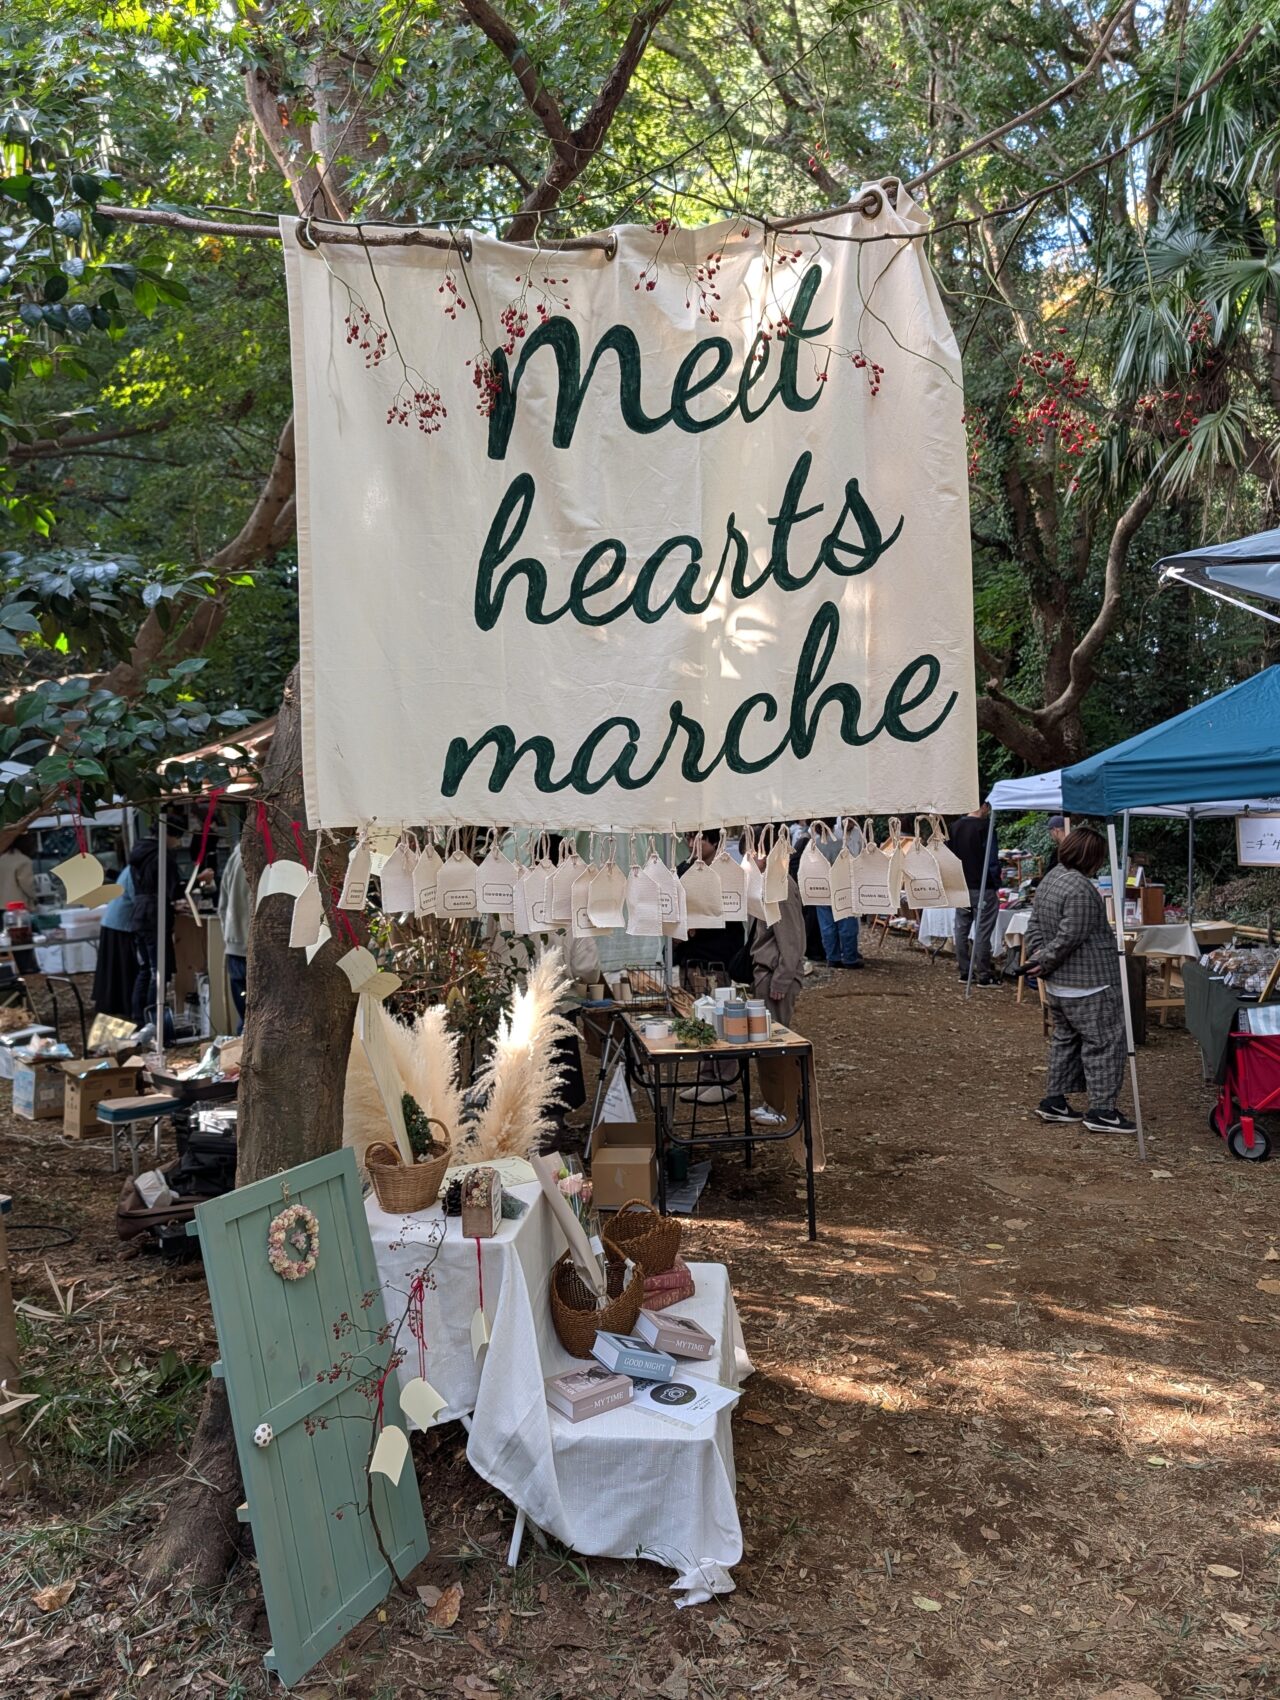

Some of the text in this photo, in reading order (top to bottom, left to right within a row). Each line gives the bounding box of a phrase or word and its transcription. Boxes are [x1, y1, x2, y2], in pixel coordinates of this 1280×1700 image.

[474, 450, 905, 631] hearts
[440, 600, 959, 797] marche
[675, 1339, 705, 1352] MY TIME
[623, 1357, 644, 1368] GOOD
[644, 1360, 666, 1372] NIGHT
[594, 1391, 624, 1409] MY TIME
